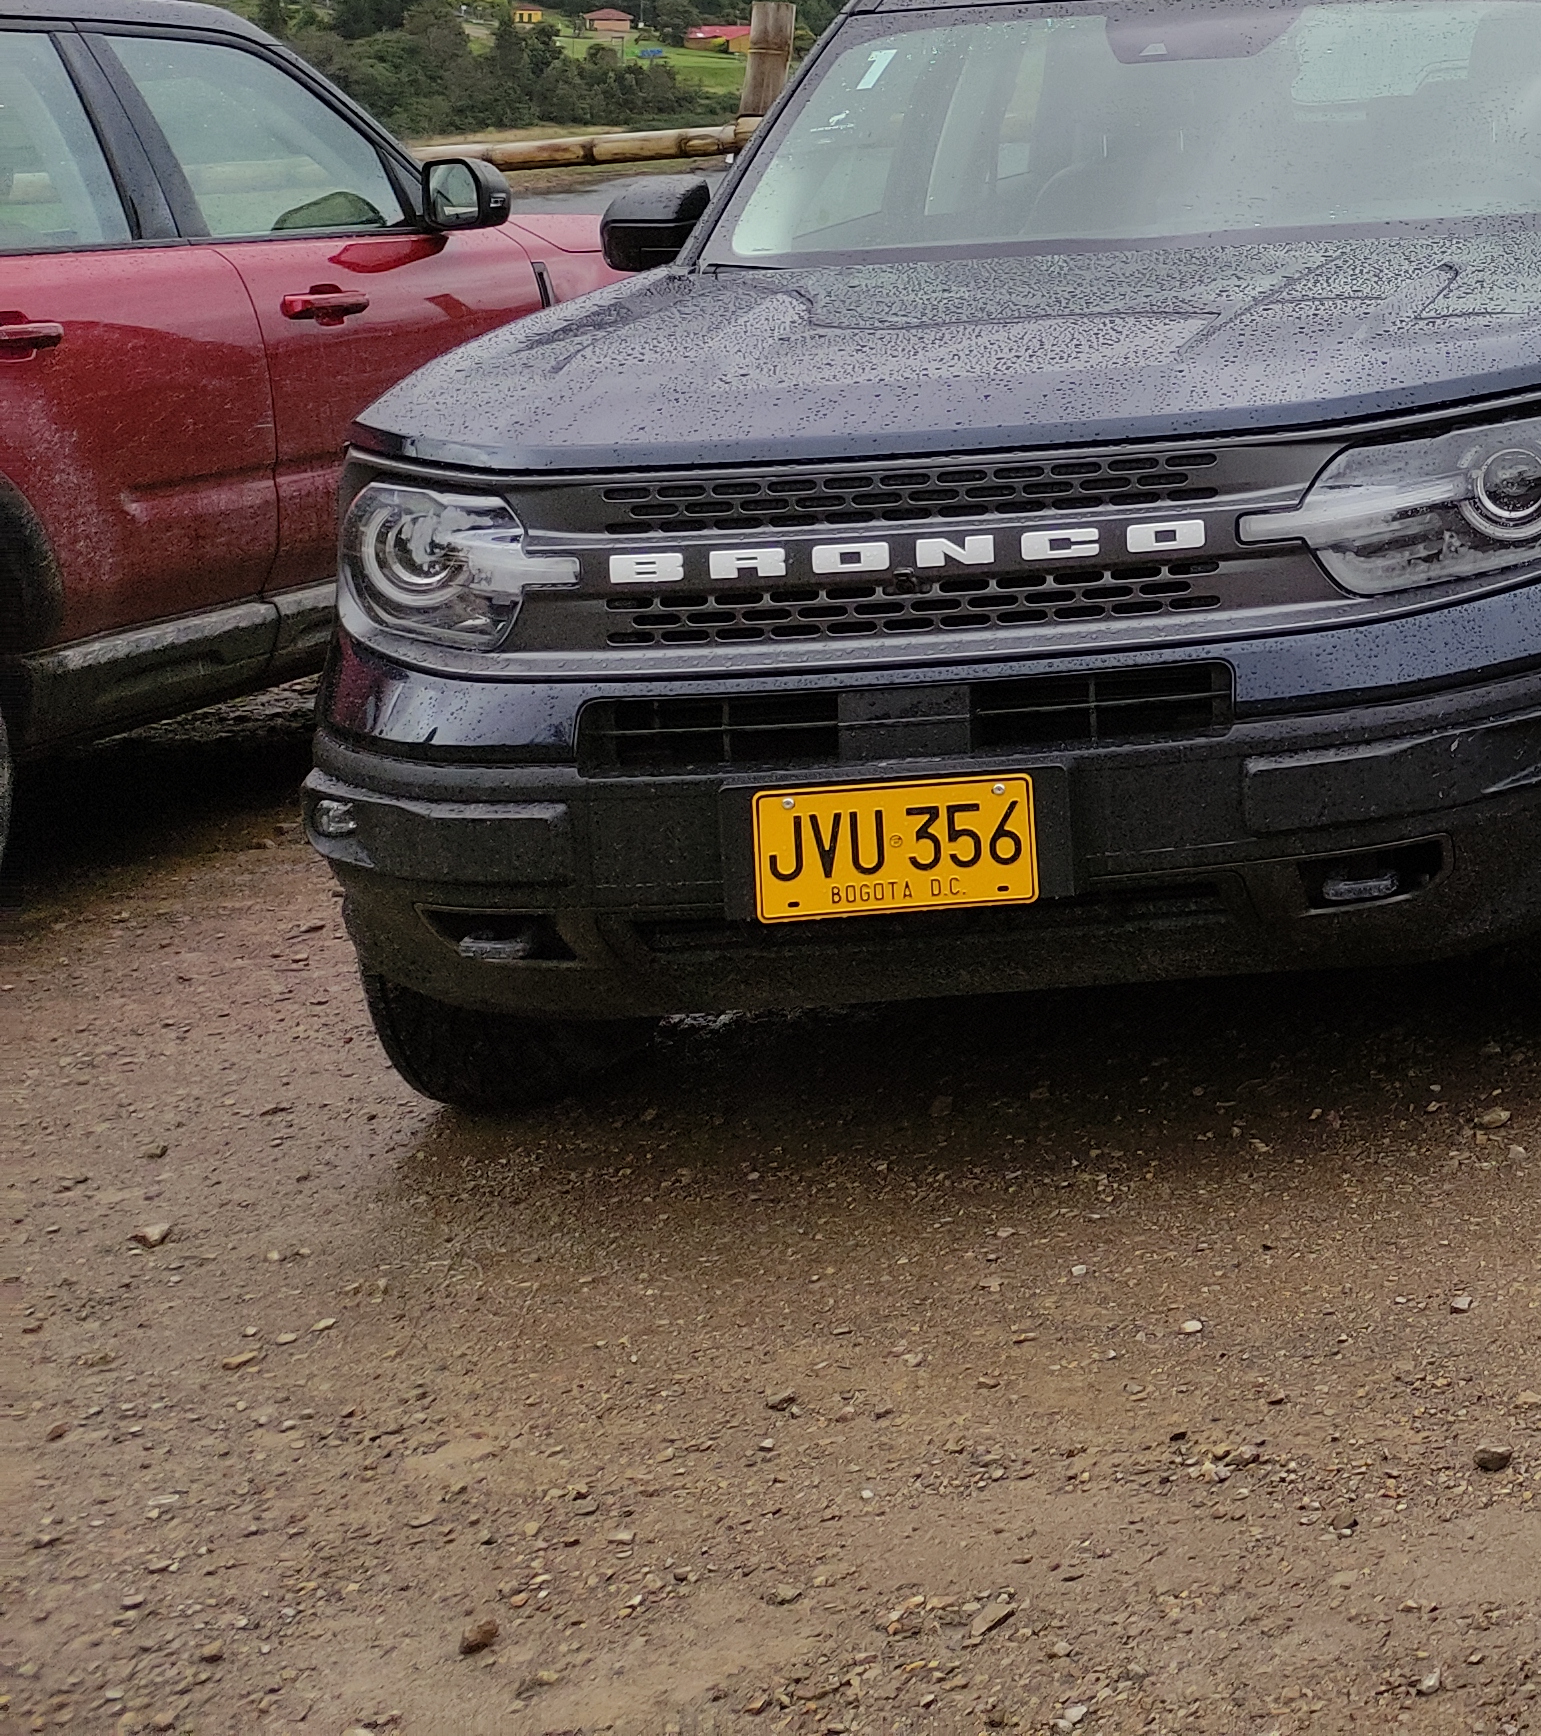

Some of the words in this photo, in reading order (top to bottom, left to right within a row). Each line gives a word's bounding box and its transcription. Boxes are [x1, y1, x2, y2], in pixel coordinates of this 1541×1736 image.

[608, 519, 1206, 584] BRONCO
[768, 808, 886, 883] JVU
[905, 799, 1023, 872] 356
[830, 880, 914, 905] BOGOTA
[929, 876, 968, 898] D.C.
